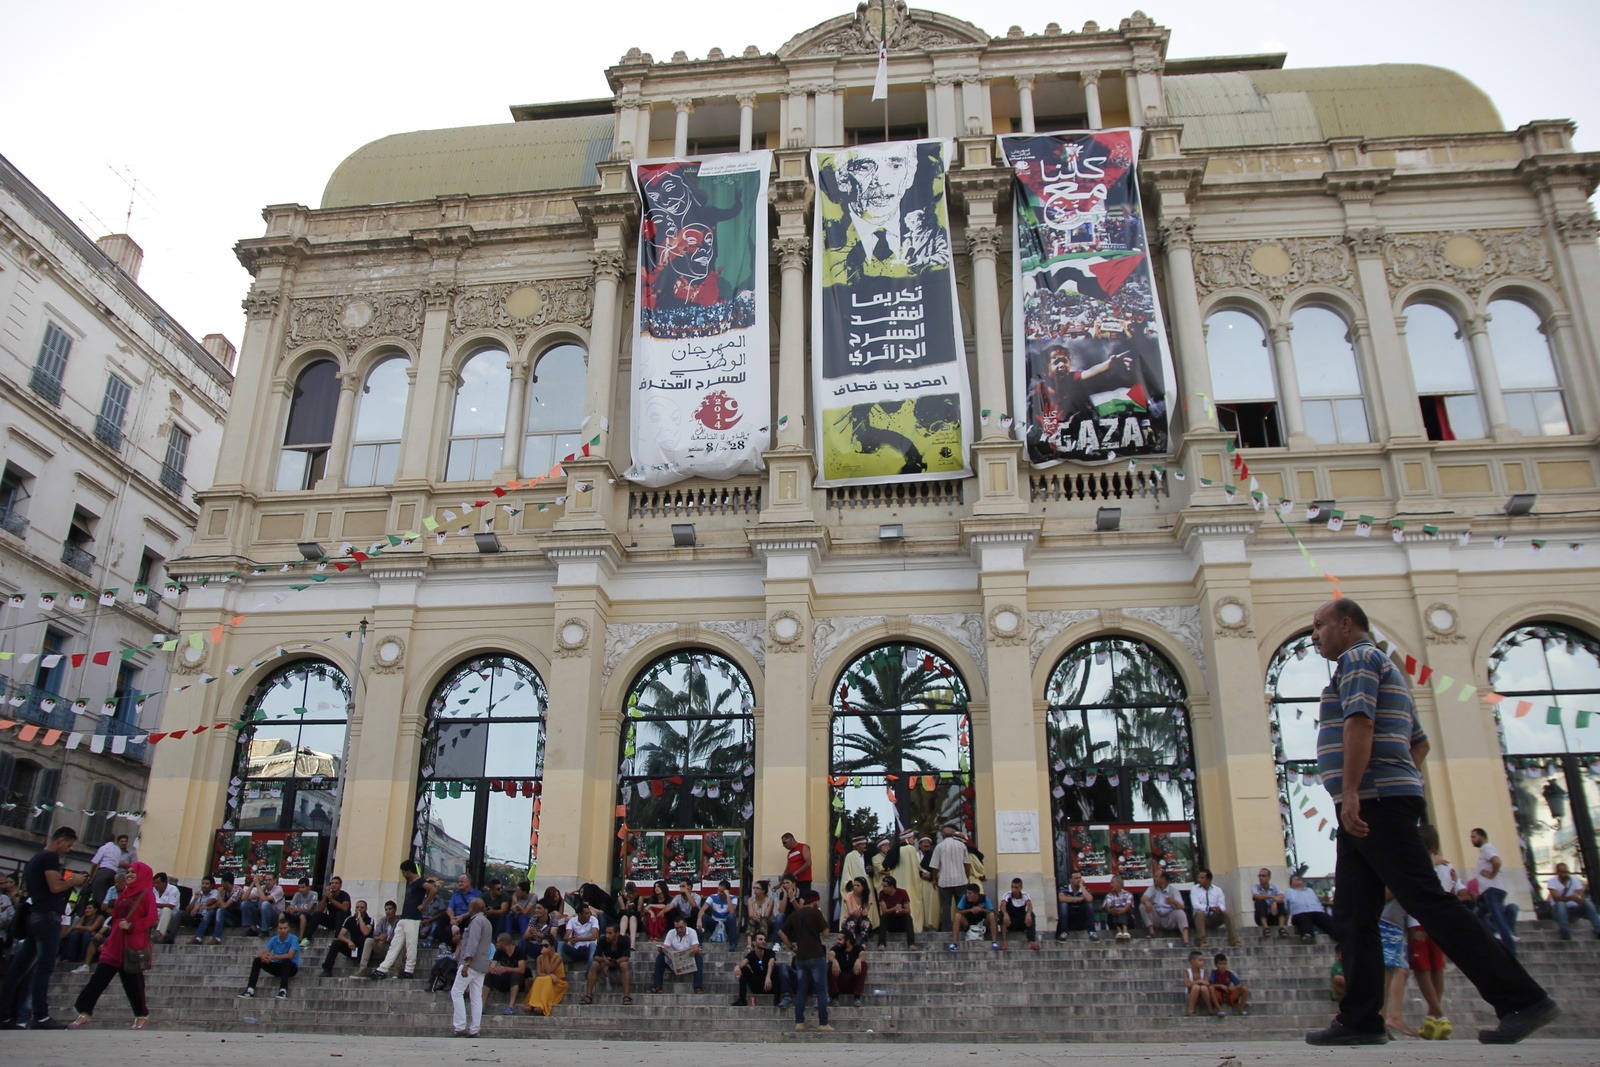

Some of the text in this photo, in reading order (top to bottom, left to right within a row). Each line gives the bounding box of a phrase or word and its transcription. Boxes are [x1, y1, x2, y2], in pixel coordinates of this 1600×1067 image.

[1040, 157, 1107, 182] كلنا
[1043, 182, 1108, 230] مع
[852, 286, 922, 307] تكريما
[850, 304, 924, 325] لفقيد
[848, 322, 924, 347] المسرح
[672, 335, 746, 361] المهرجان
[848, 342, 926, 366] الجزائري
[670, 353, 746, 378] الوطني
[639, 372, 746, 390] للمسرح المحترف
[832, 380, 878, 396] قطاف
[904, 376, 948, 390] امحمد
[730, 440, 745, 450] 28
[1056, 417, 1144, 452] GAZA
